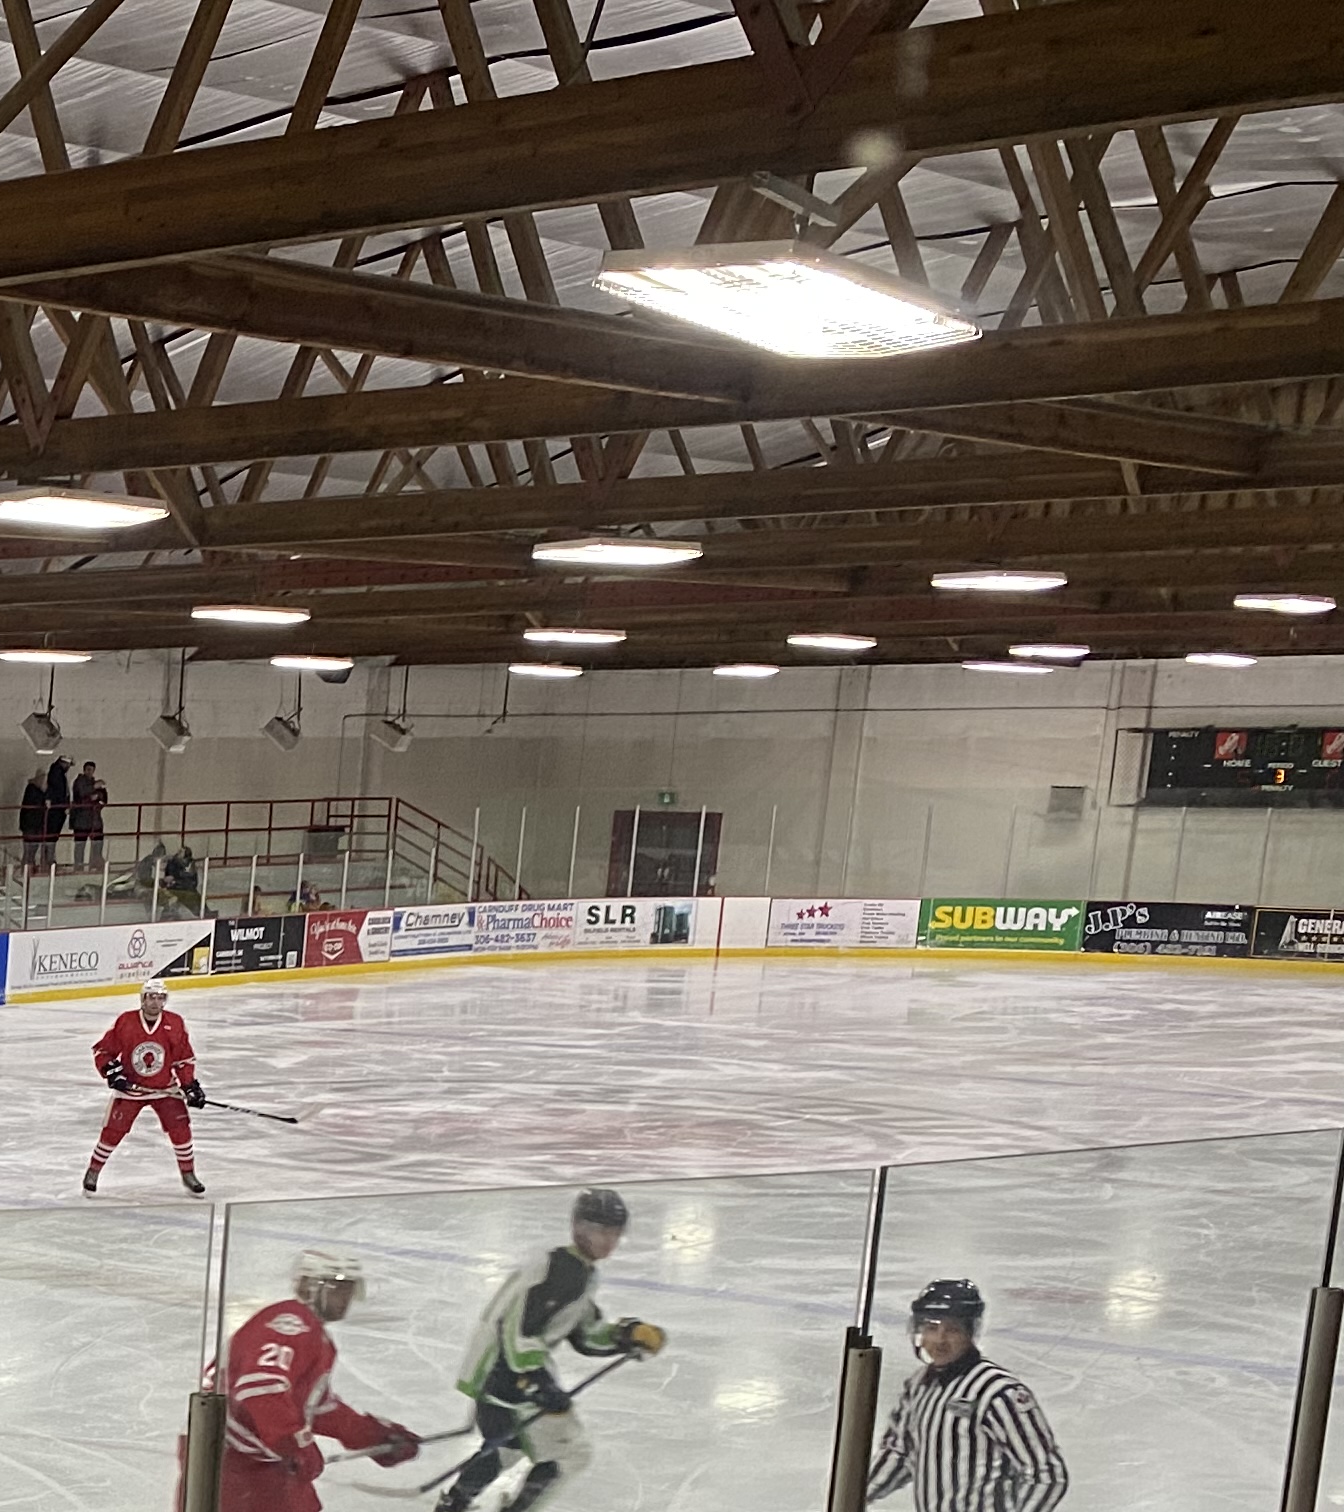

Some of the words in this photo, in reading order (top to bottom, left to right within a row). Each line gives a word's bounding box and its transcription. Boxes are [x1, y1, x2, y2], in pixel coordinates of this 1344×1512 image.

[1223, 759, 1252, 767] HOME
[1312, 759, 1343, 767] GUEST
[478, 904, 519, 913] CARNDUFF
[521, 903, 545, 912] DRUG
[547, 903, 574, 911] MART
[586, 904, 637, 926] SLR
[486, 912, 573, 930] PharmaChoice
[929, 905, 1080, 931] SUBWAY
[230, 926, 265, 941] WILMOT
[37, 951, 99, 973] KENECO
